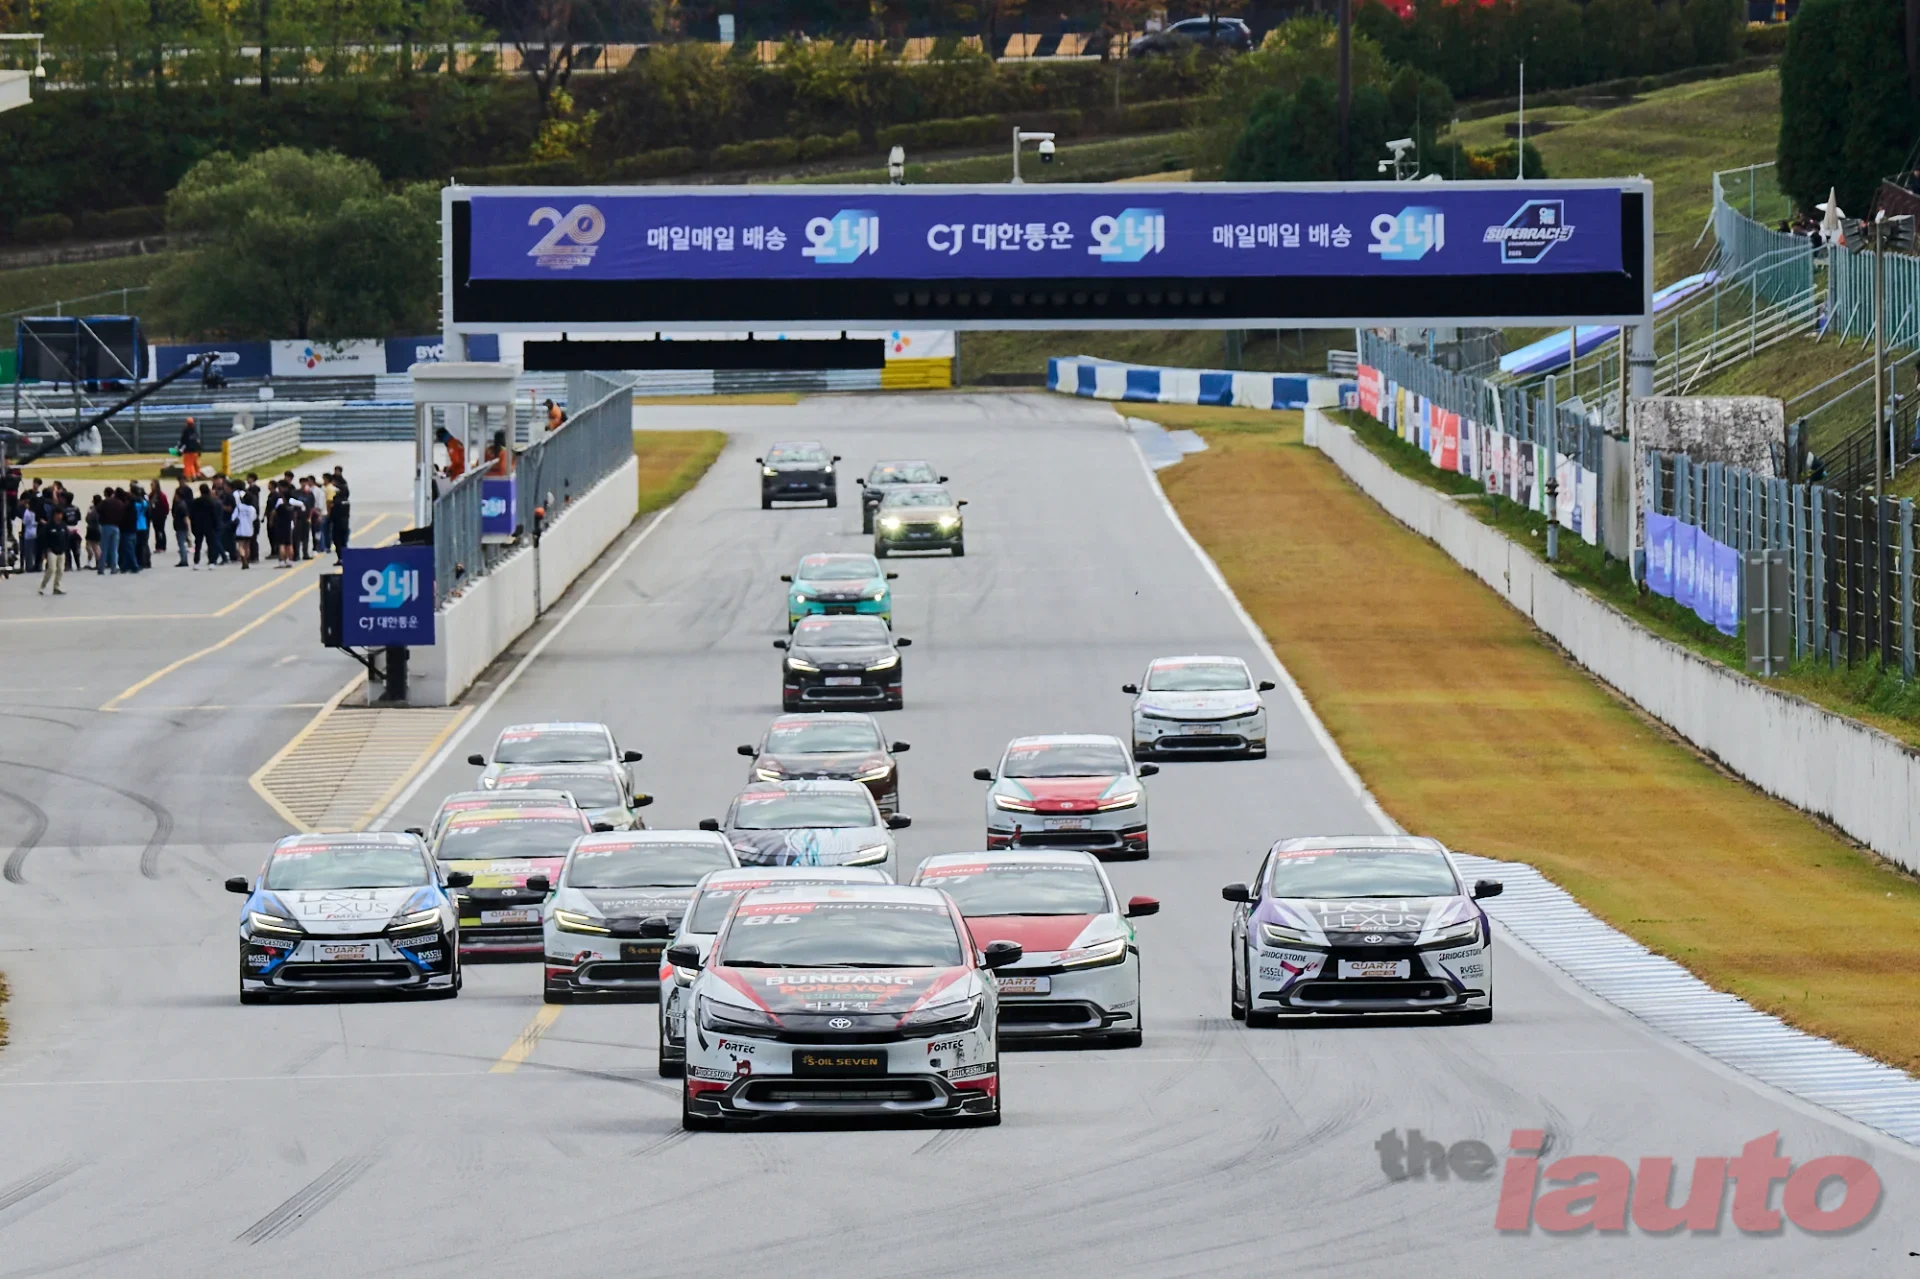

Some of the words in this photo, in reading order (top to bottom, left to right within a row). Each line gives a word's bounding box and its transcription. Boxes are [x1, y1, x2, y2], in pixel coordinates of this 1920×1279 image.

[647, 226, 735, 251] 매일매일
[742, 226, 788, 251] 배송
[801, 216, 880, 256] 오네
[926, 223, 966, 255] CJ
[971, 221, 1074, 252] 대한통운
[1087, 214, 1166, 255] 오네
[1212, 223, 1301, 249] 매일매일
[1307, 223, 1353, 248] 배송
[1367, 213, 1445, 253] 오네
[358, 569, 419, 603] 오네
[358, 616, 375, 631] CJ
[376, 615, 419, 629] 대한통운
[303, 902, 389, 916] LEXUS
[755, 904, 812, 912] PRIUS
[870, 904, 934, 912] CLASS
[742, 914, 801, 926] 86
[1323, 913, 1422, 928] LEXUS
[324, 946, 366, 954] QUARTZ
[1259, 949, 1308, 963] BRIDGESTONE
[1438, 947, 1484, 962] BRIDGESTONE
[1259, 964, 1284, 977] RUSSELL
[1350, 962, 1398, 970] QUARTZ
[1459, 963, 1484, 975] RUSSELL
[765, 974, 914, 986] BUNDANG
[998, 977, 1037, 986] UARTZ
[717, 1038, 756, 1055] FORTEC
[926, 1039, 964, 1056] FORTEC
[807, 1058, 835, 1066] S-OIL
[835, 1058, 878, 1066] SEVEN
[694, 1068, 733, 1079] BRIDGESTONE
[948, 1063, 987, 1079] BRIDGESTONE
